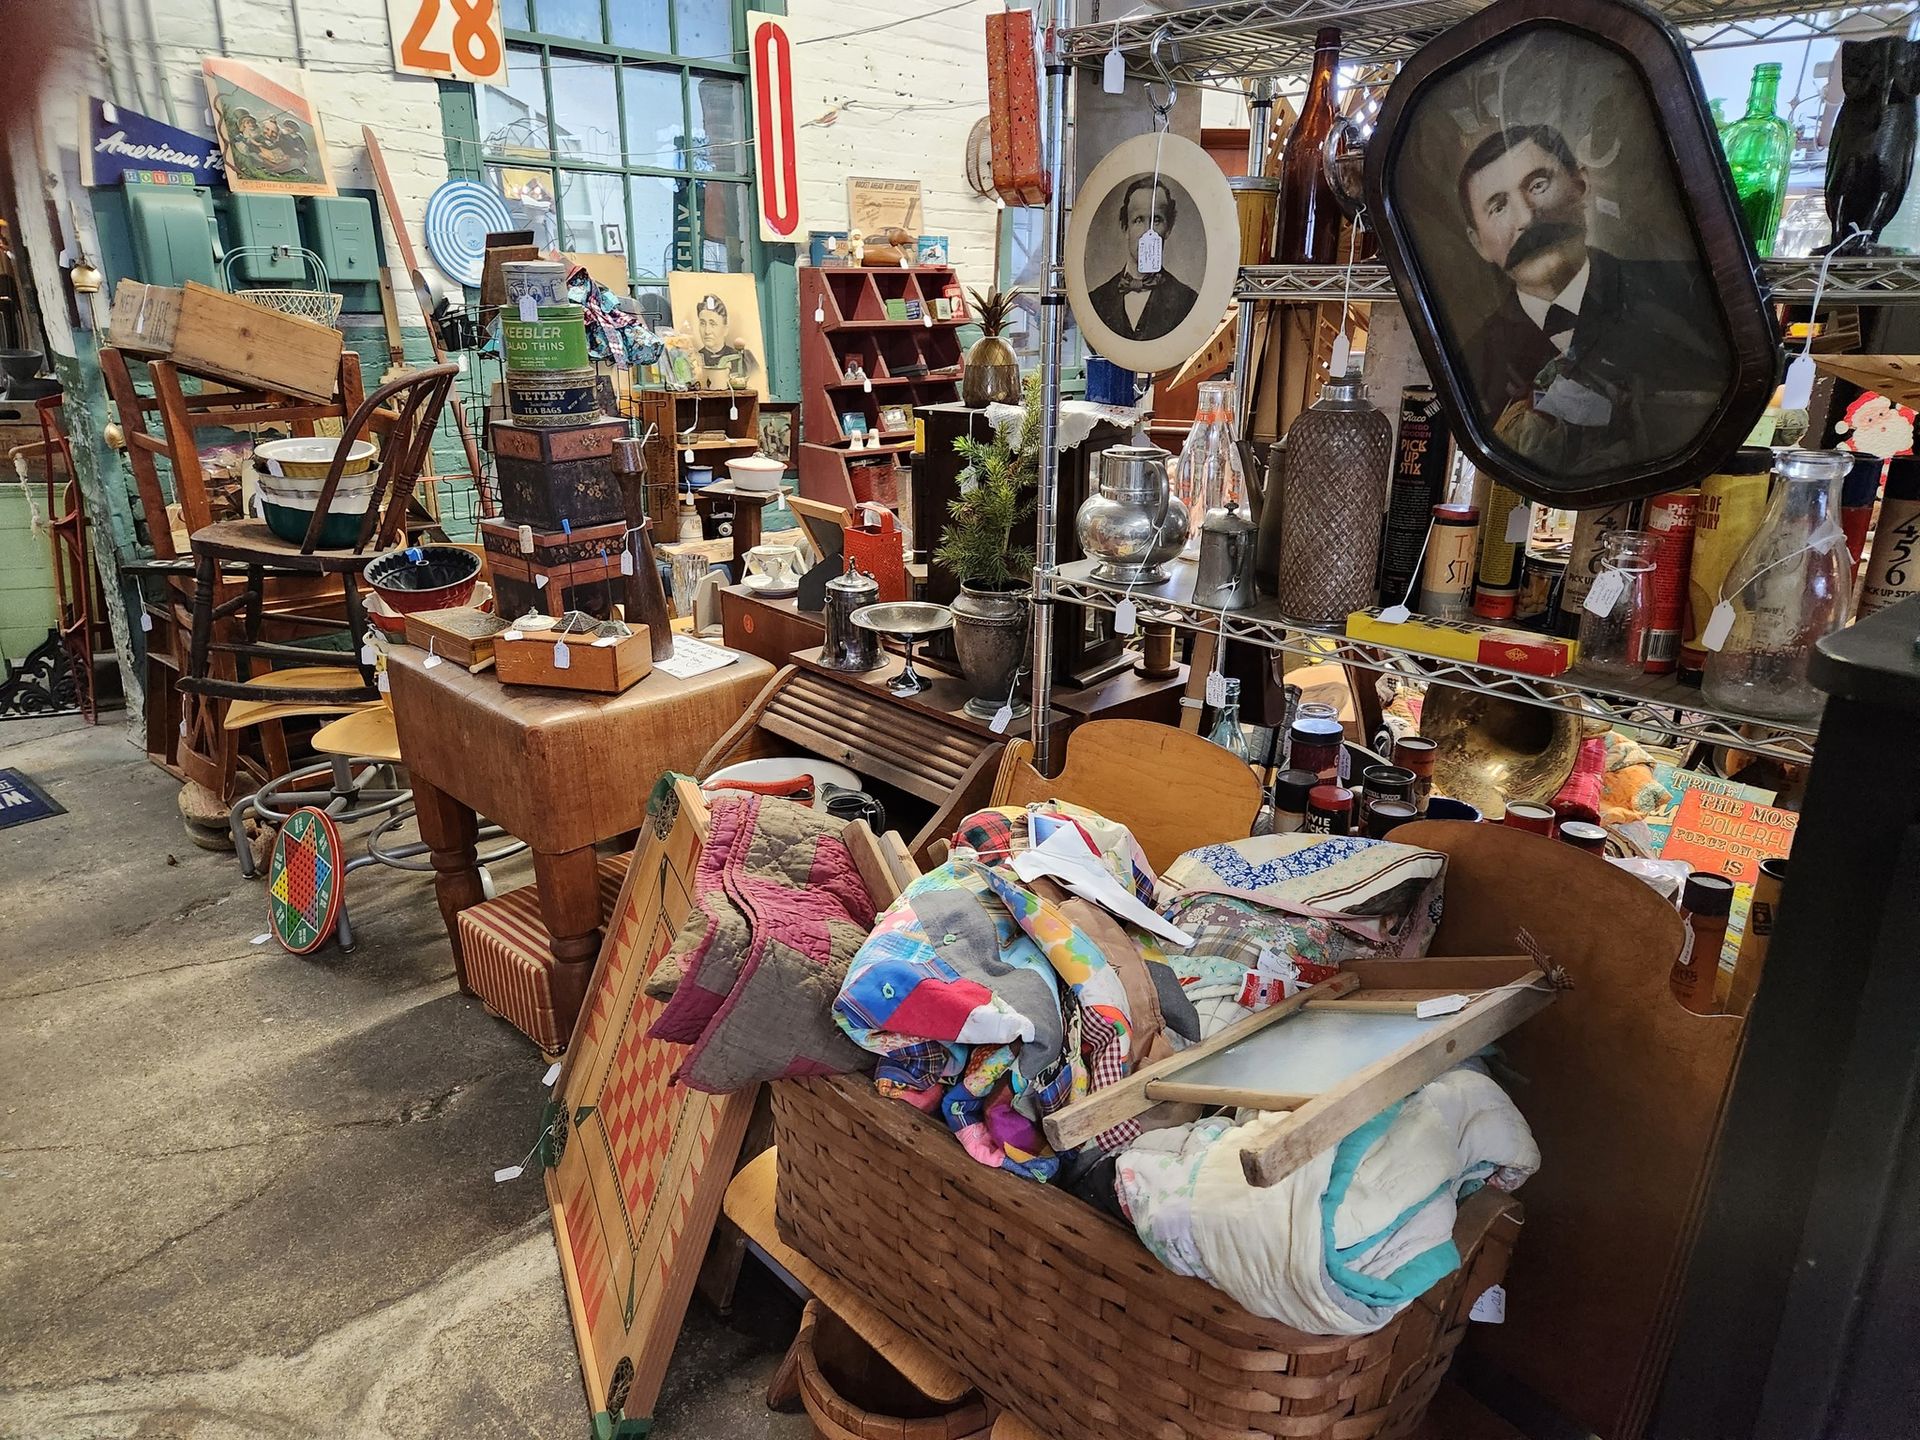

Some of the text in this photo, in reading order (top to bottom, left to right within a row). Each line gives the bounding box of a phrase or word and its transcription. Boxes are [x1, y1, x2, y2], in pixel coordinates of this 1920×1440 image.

[401, 0, 501, 76] 28
[95, 131, 200, 168] American
[126, 171, 193, 185] HOUDE
[505, 326, 561, 339] KEEBLER
[531, 341, 565, 351] THINS
[517, 391, 566, 401] TETLEY
[1401, 439, 1428, 452] PICK
[1404, 450, 1419, 463] UP
[1892, 513, 1920, 538] 4
[1888, 535, 1920, 562] 5
[1885, 559, 1912, 587] 6
[1881, 588, 1894, 598] UP
[1699, 793, 1745, 817] THE
[1750, 805, 1799, 831] MOS
[1674, 827, 1727, 851] FORCE
[1729, 842, 1752, 858] ON
[1700, 814, 1788, 851] POWERFU
[1721, 858, 1744, 876] IS
